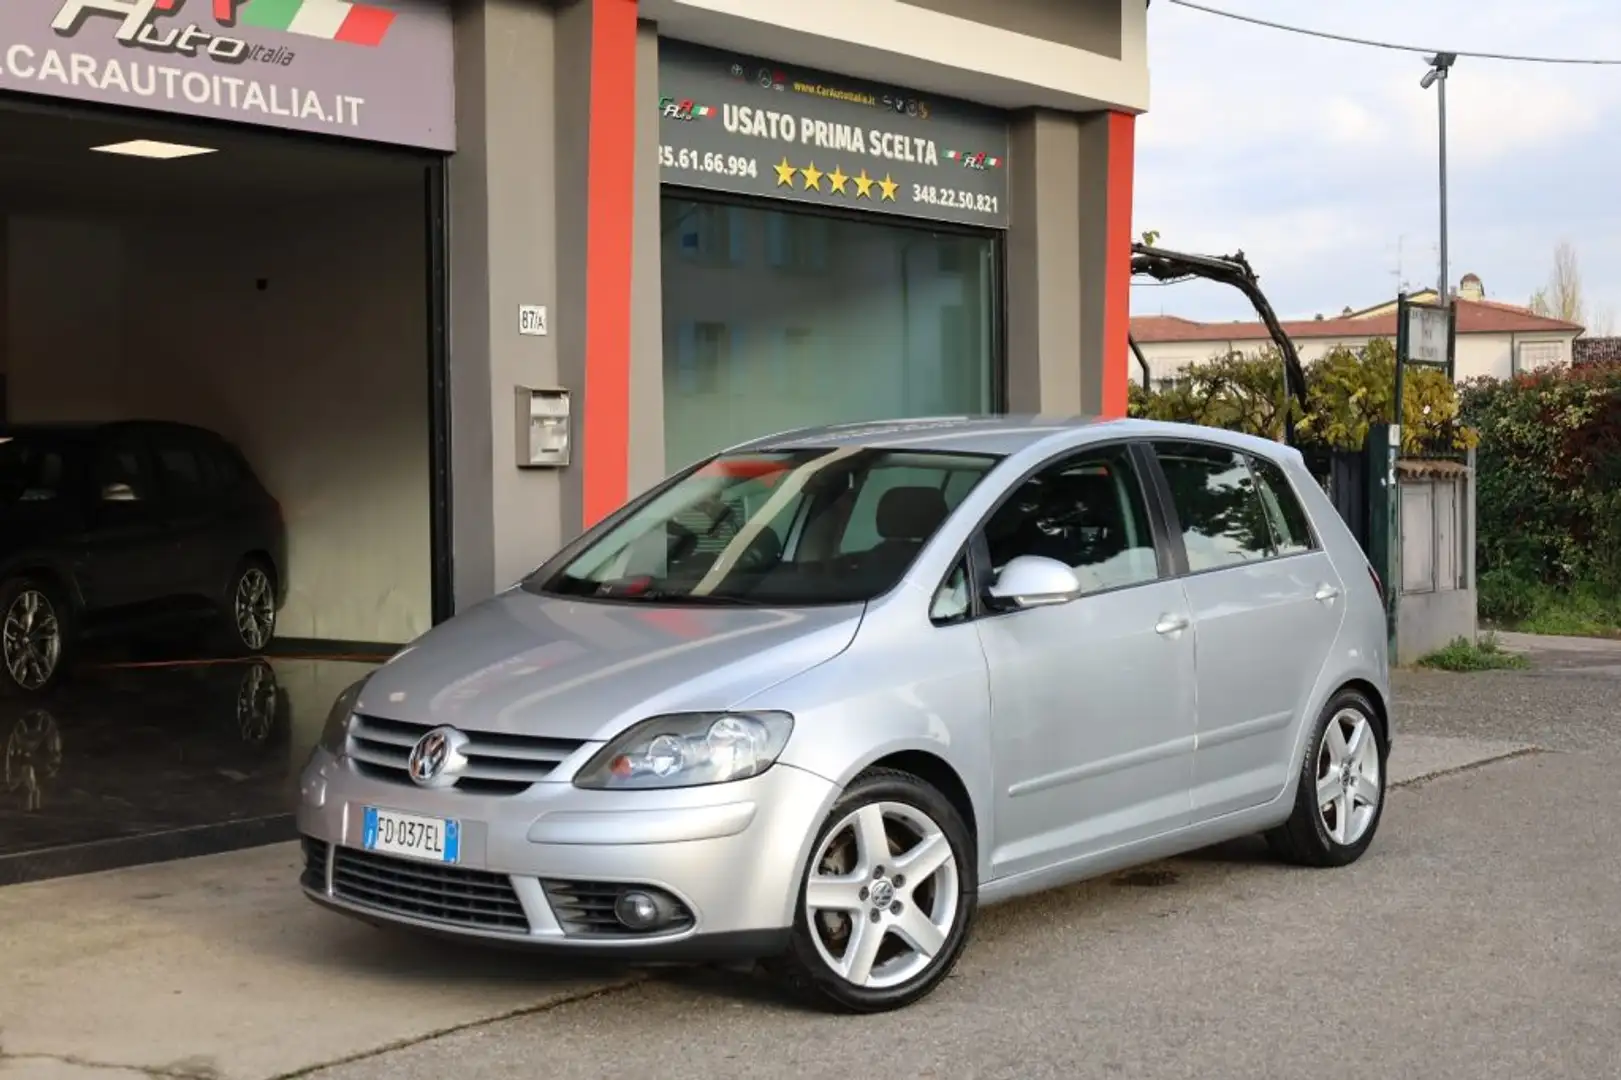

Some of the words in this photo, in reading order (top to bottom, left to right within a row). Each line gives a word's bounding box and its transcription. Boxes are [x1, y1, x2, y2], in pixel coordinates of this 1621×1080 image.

[723, 103, 796, 142] USATO
[800, 117, 865, 154] PRIMA
[868, 129, 938, 166] SCELTA
[912, 183, 998, 214] 348.22.50.821
[521, 310, 544, 329] 87/A
